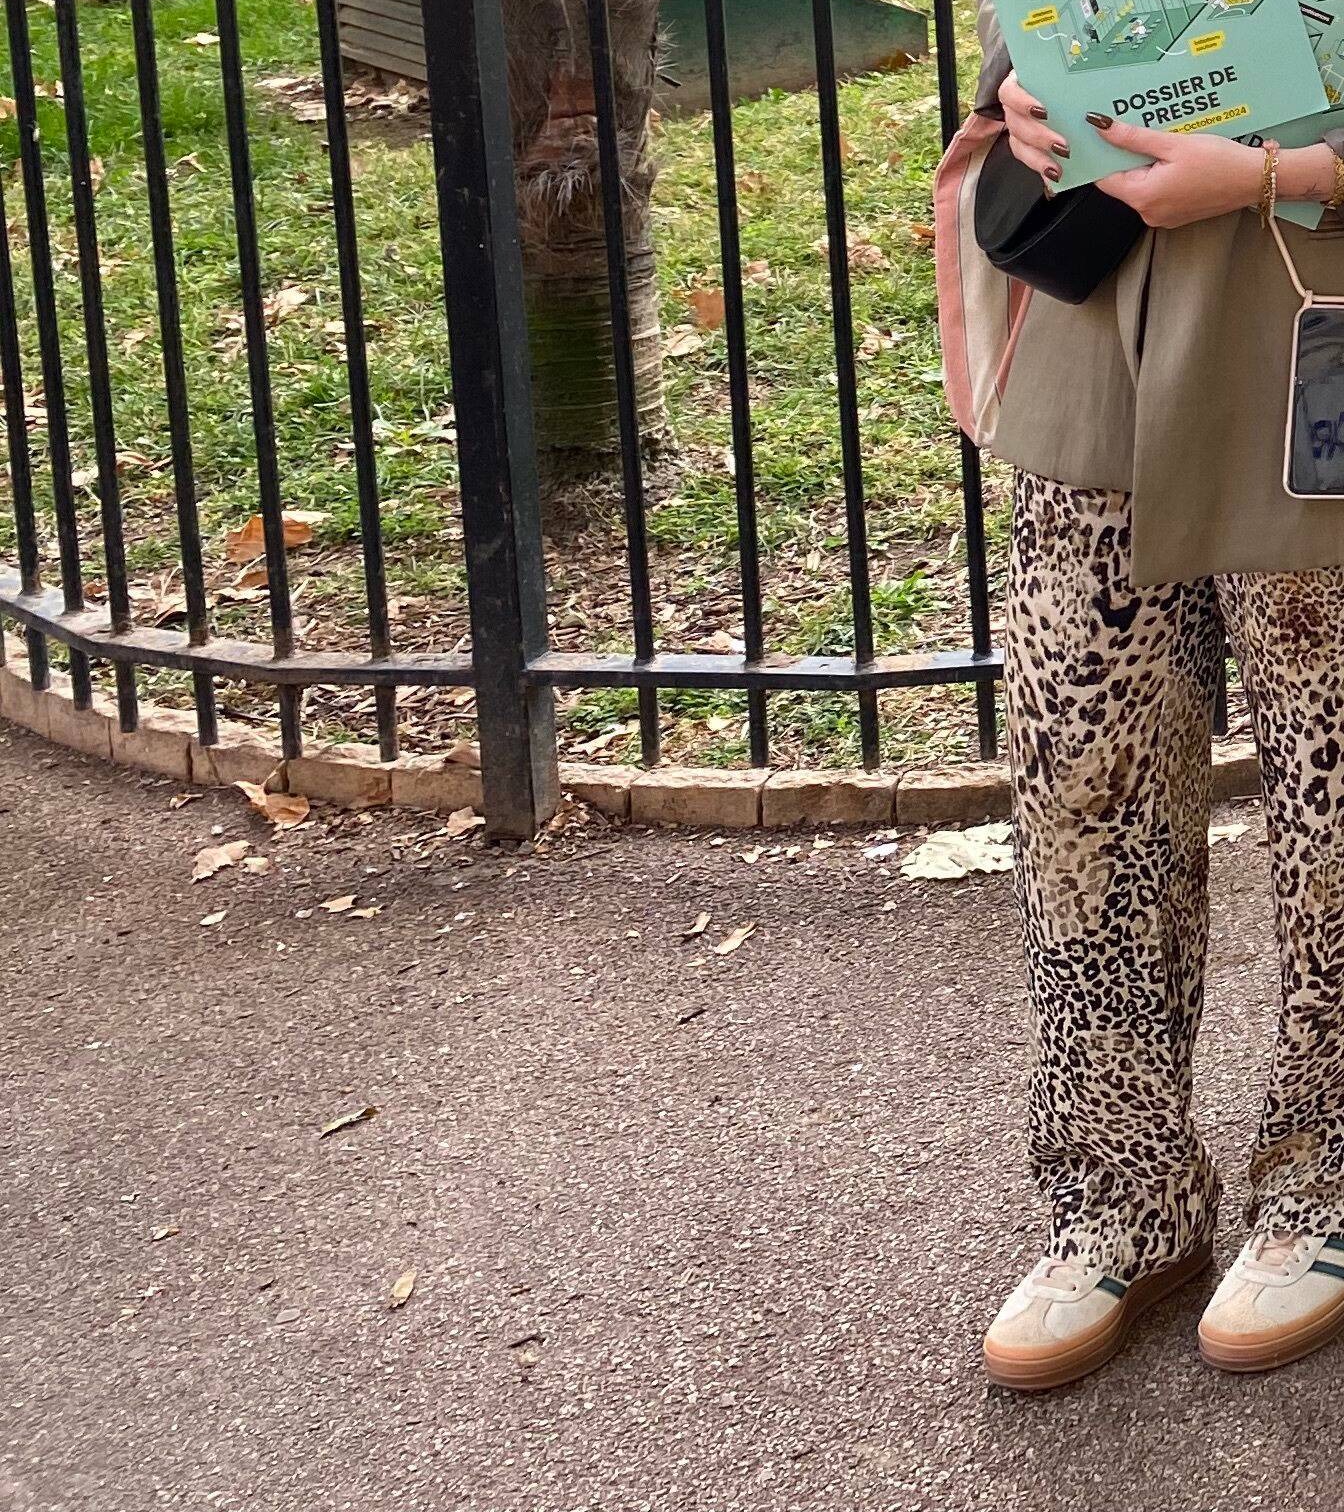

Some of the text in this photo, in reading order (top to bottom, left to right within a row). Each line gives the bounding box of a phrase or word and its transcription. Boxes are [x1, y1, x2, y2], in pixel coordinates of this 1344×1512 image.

[1112, 65, 1238, 116] DOSSIER DE
[1141, 91, 1221, 128] PRESSE
[1222, 106, 1247, 120] 2024
